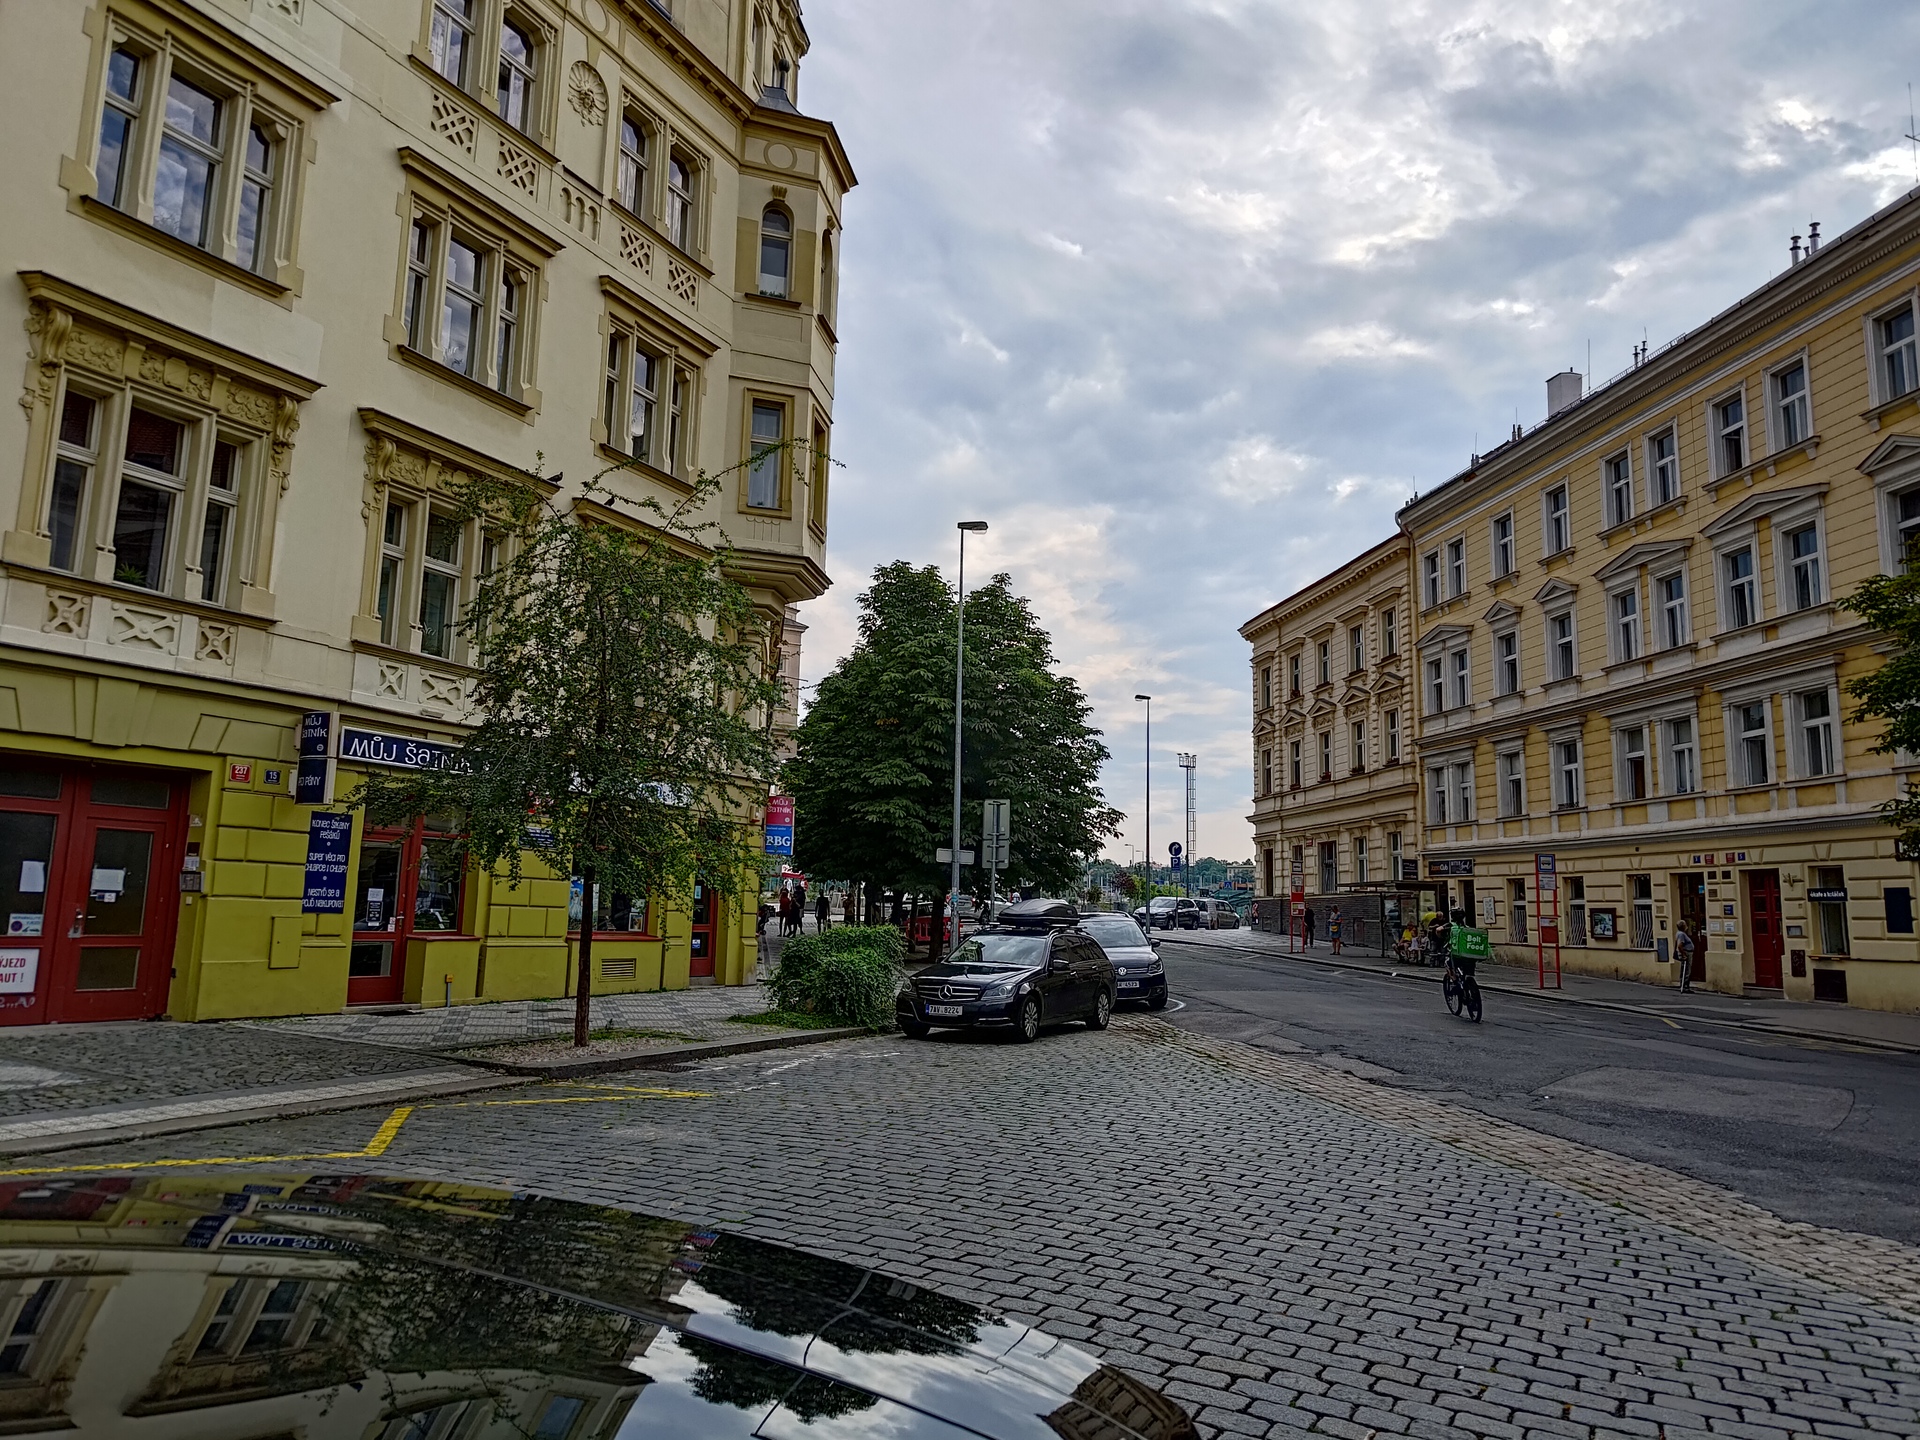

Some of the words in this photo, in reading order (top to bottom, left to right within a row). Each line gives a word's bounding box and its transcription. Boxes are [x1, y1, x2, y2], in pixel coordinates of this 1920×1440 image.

[348, 736, 397, 761] MŮJ
[234, 765, 248, 775] 237
[269, 771, 278, 780] 15
[1467, 935, 1481, 943] Bolt
[1467, 942, 1484, 951] Food
